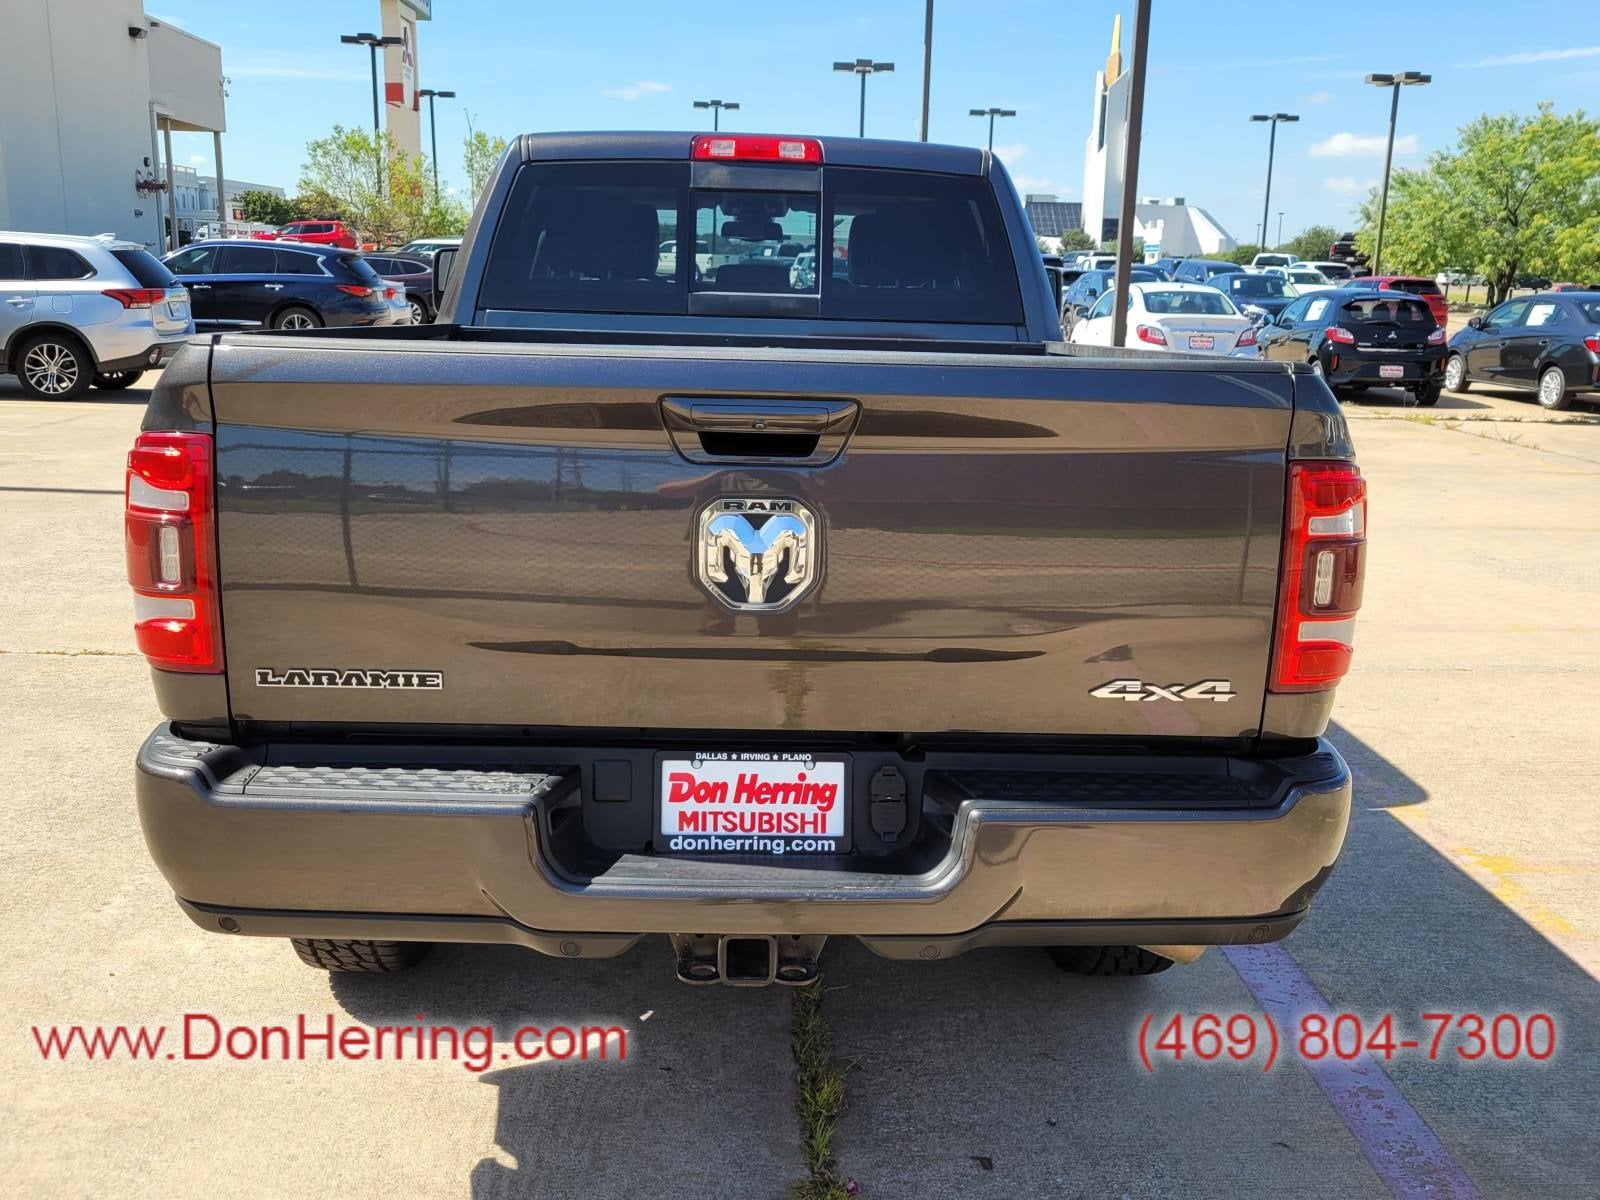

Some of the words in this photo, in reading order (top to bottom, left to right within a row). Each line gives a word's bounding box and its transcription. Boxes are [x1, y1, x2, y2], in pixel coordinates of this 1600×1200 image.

[723, 501, 792, 511] RAM
[255, 669, 443, 690] LARAMIE
[695, 752, 728, 761] DALLAS
[740, 753, 770, 761] IRVING
[782, 753, 812, 761] PLANO
[668, 772, 730, 803] Don
[733, 772, 838, 812] Herring
[678, 811, 827, 833] MITSUBISHI
[669, 836, 836, 854] donherring.com
